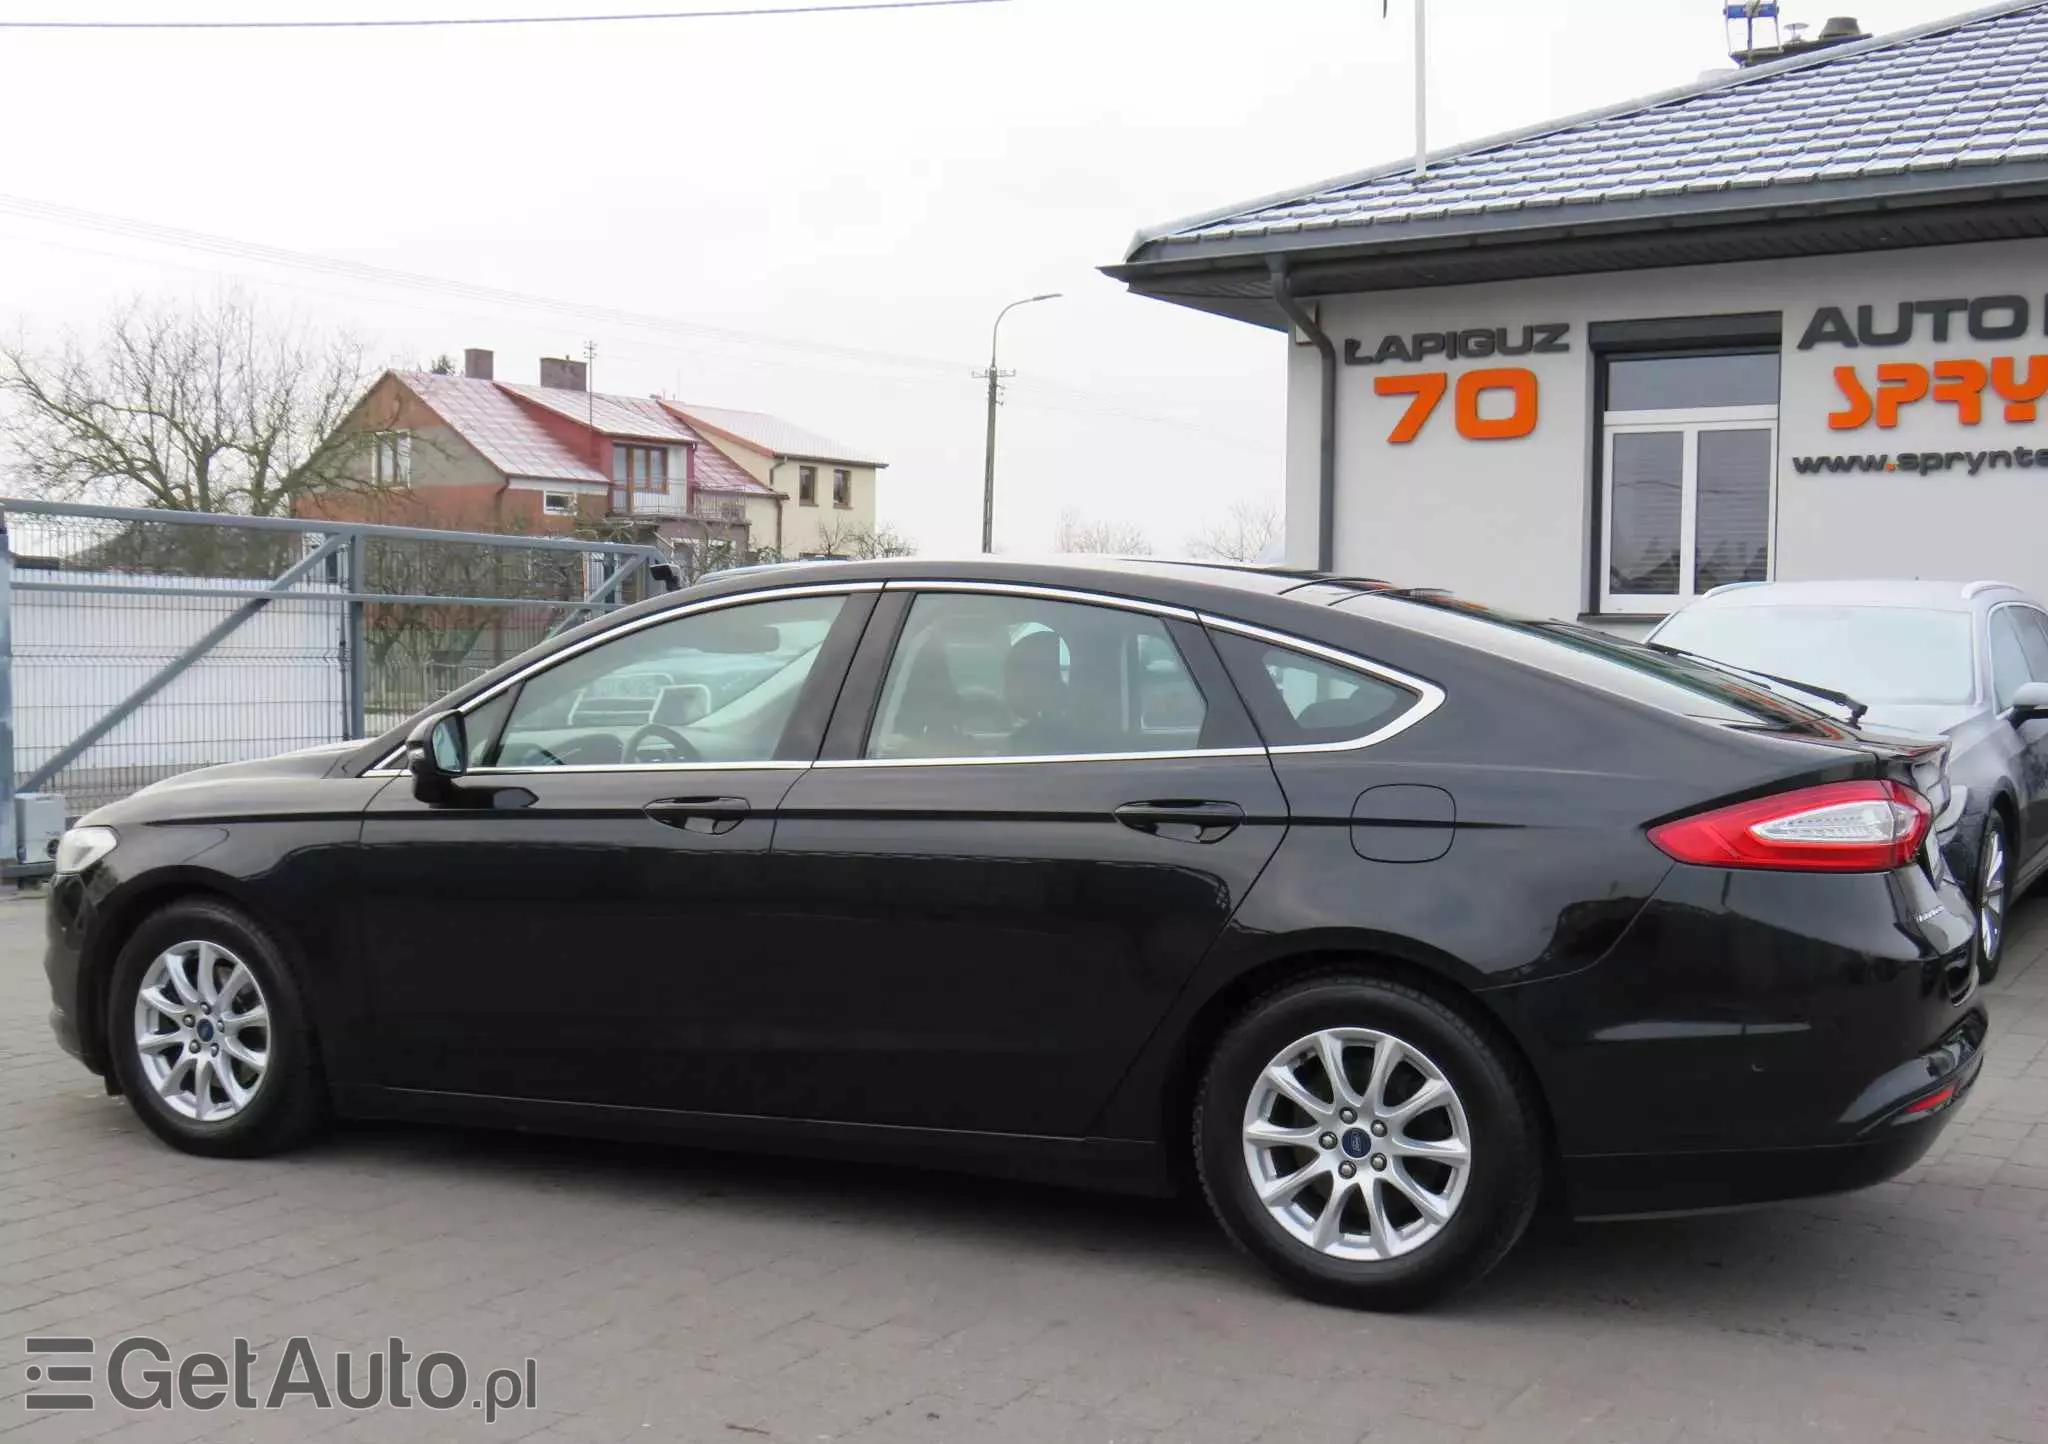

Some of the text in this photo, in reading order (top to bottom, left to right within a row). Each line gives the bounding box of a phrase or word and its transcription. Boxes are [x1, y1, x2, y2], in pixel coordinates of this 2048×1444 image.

[1345, 323, 1570, 366] ŁAPIGUZ
[1797, 294, 2029, 350] AUTO
[1373, 367, 1539, 445] 70
[1828, 354, 2048, 430] SPRY
